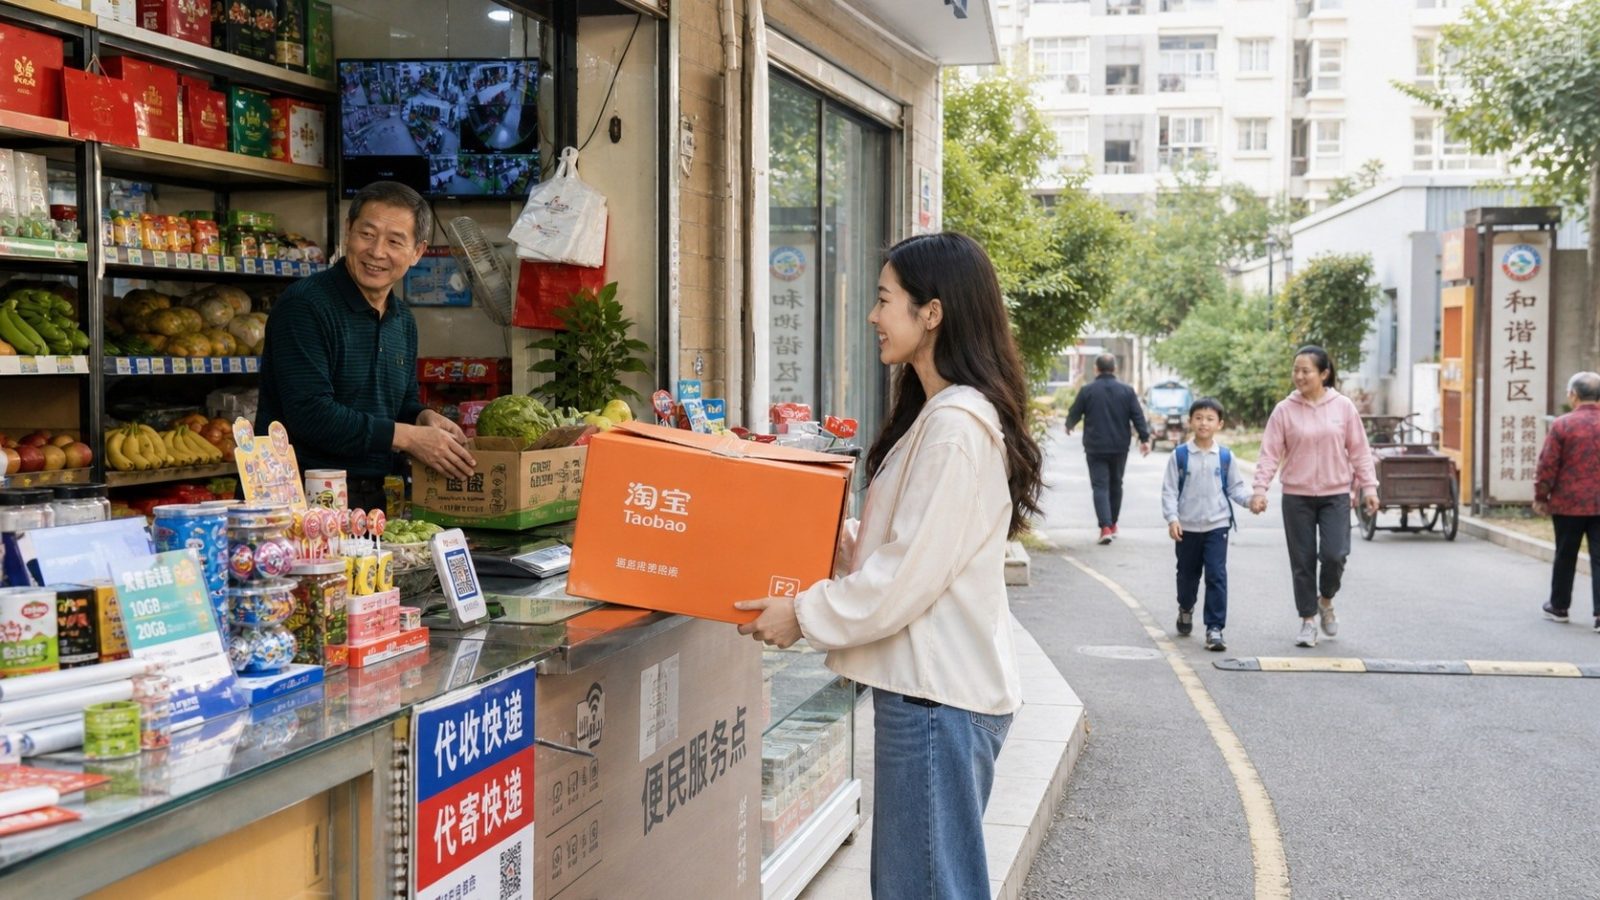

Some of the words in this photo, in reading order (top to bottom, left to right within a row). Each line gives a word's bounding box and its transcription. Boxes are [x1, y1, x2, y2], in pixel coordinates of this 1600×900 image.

[1504, 289, 1536, 402] 和谐社区
[624, 481, 692, 516] 淘宝
[623, 509, 687, 533] Taobao
[774, 580, 796, 597] F2
[129, 598, 161, 618] 10GB
[136, 621, 168, 641] 20GB
[434, 688, 523, 778] 代收快递
[641, 705, 747, 837] 便民服务点
[433, 766, 523, 864] 代寄快递
